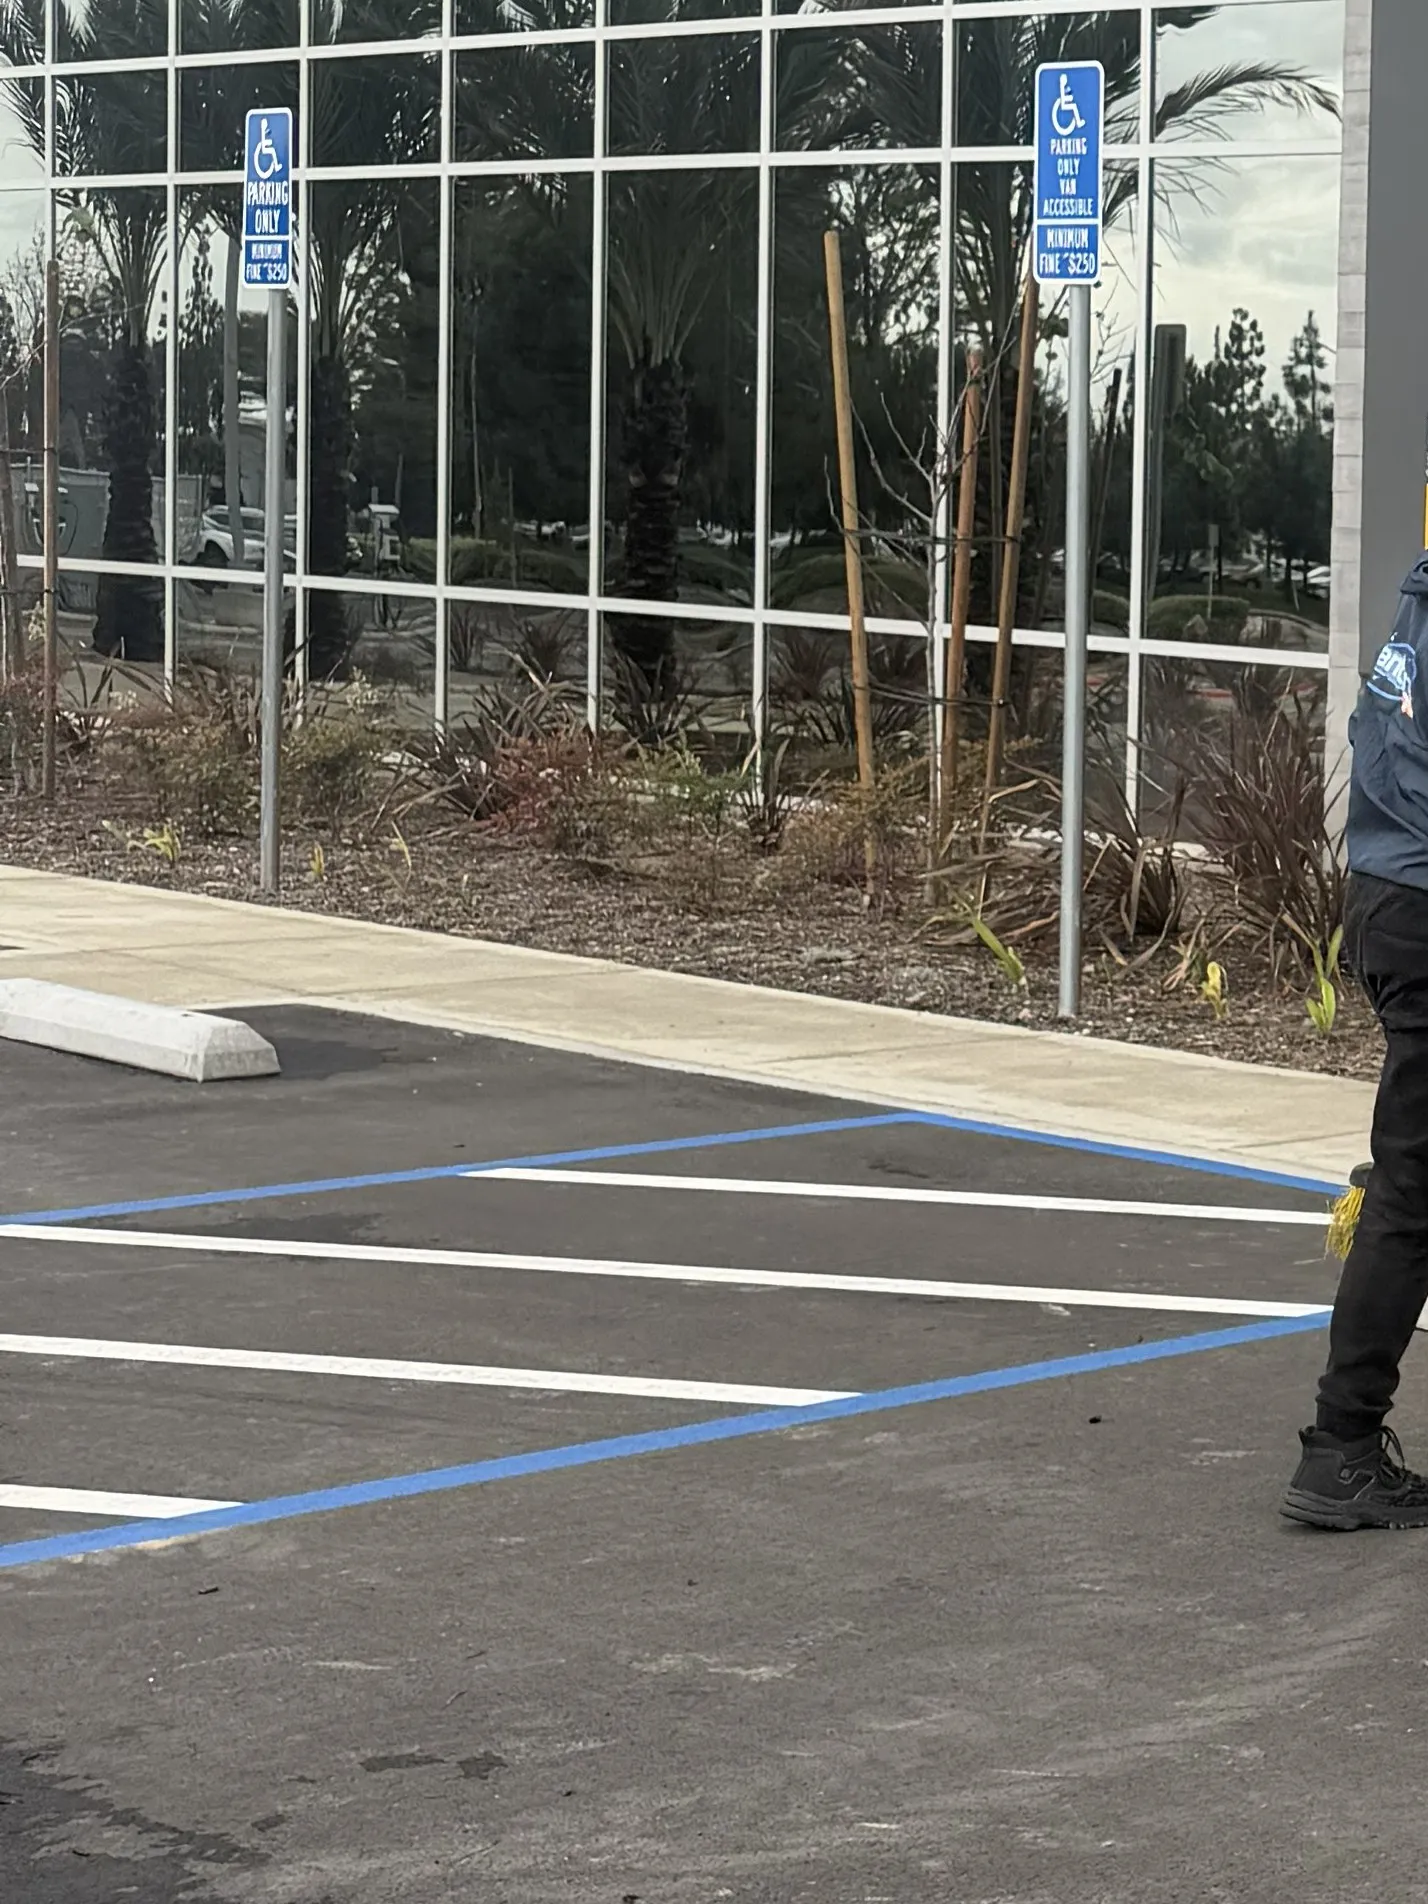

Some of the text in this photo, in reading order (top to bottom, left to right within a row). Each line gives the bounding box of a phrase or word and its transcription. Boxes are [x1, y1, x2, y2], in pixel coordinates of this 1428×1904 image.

[1050, 137, 1087, 156] PARKING
[1057, 158, 1079, 176] ONLY
[247, 181, 288, 206] PARKING
[1059, 179, 1077, 196] VAN
[1043, 198, 1093, 217] ACCESSIBLE
[254, 208, 281, 234] ONLY
[1046, 228, 1089, 249] MINIMUM
[1039, 253, 1096, 277] FINE $250
